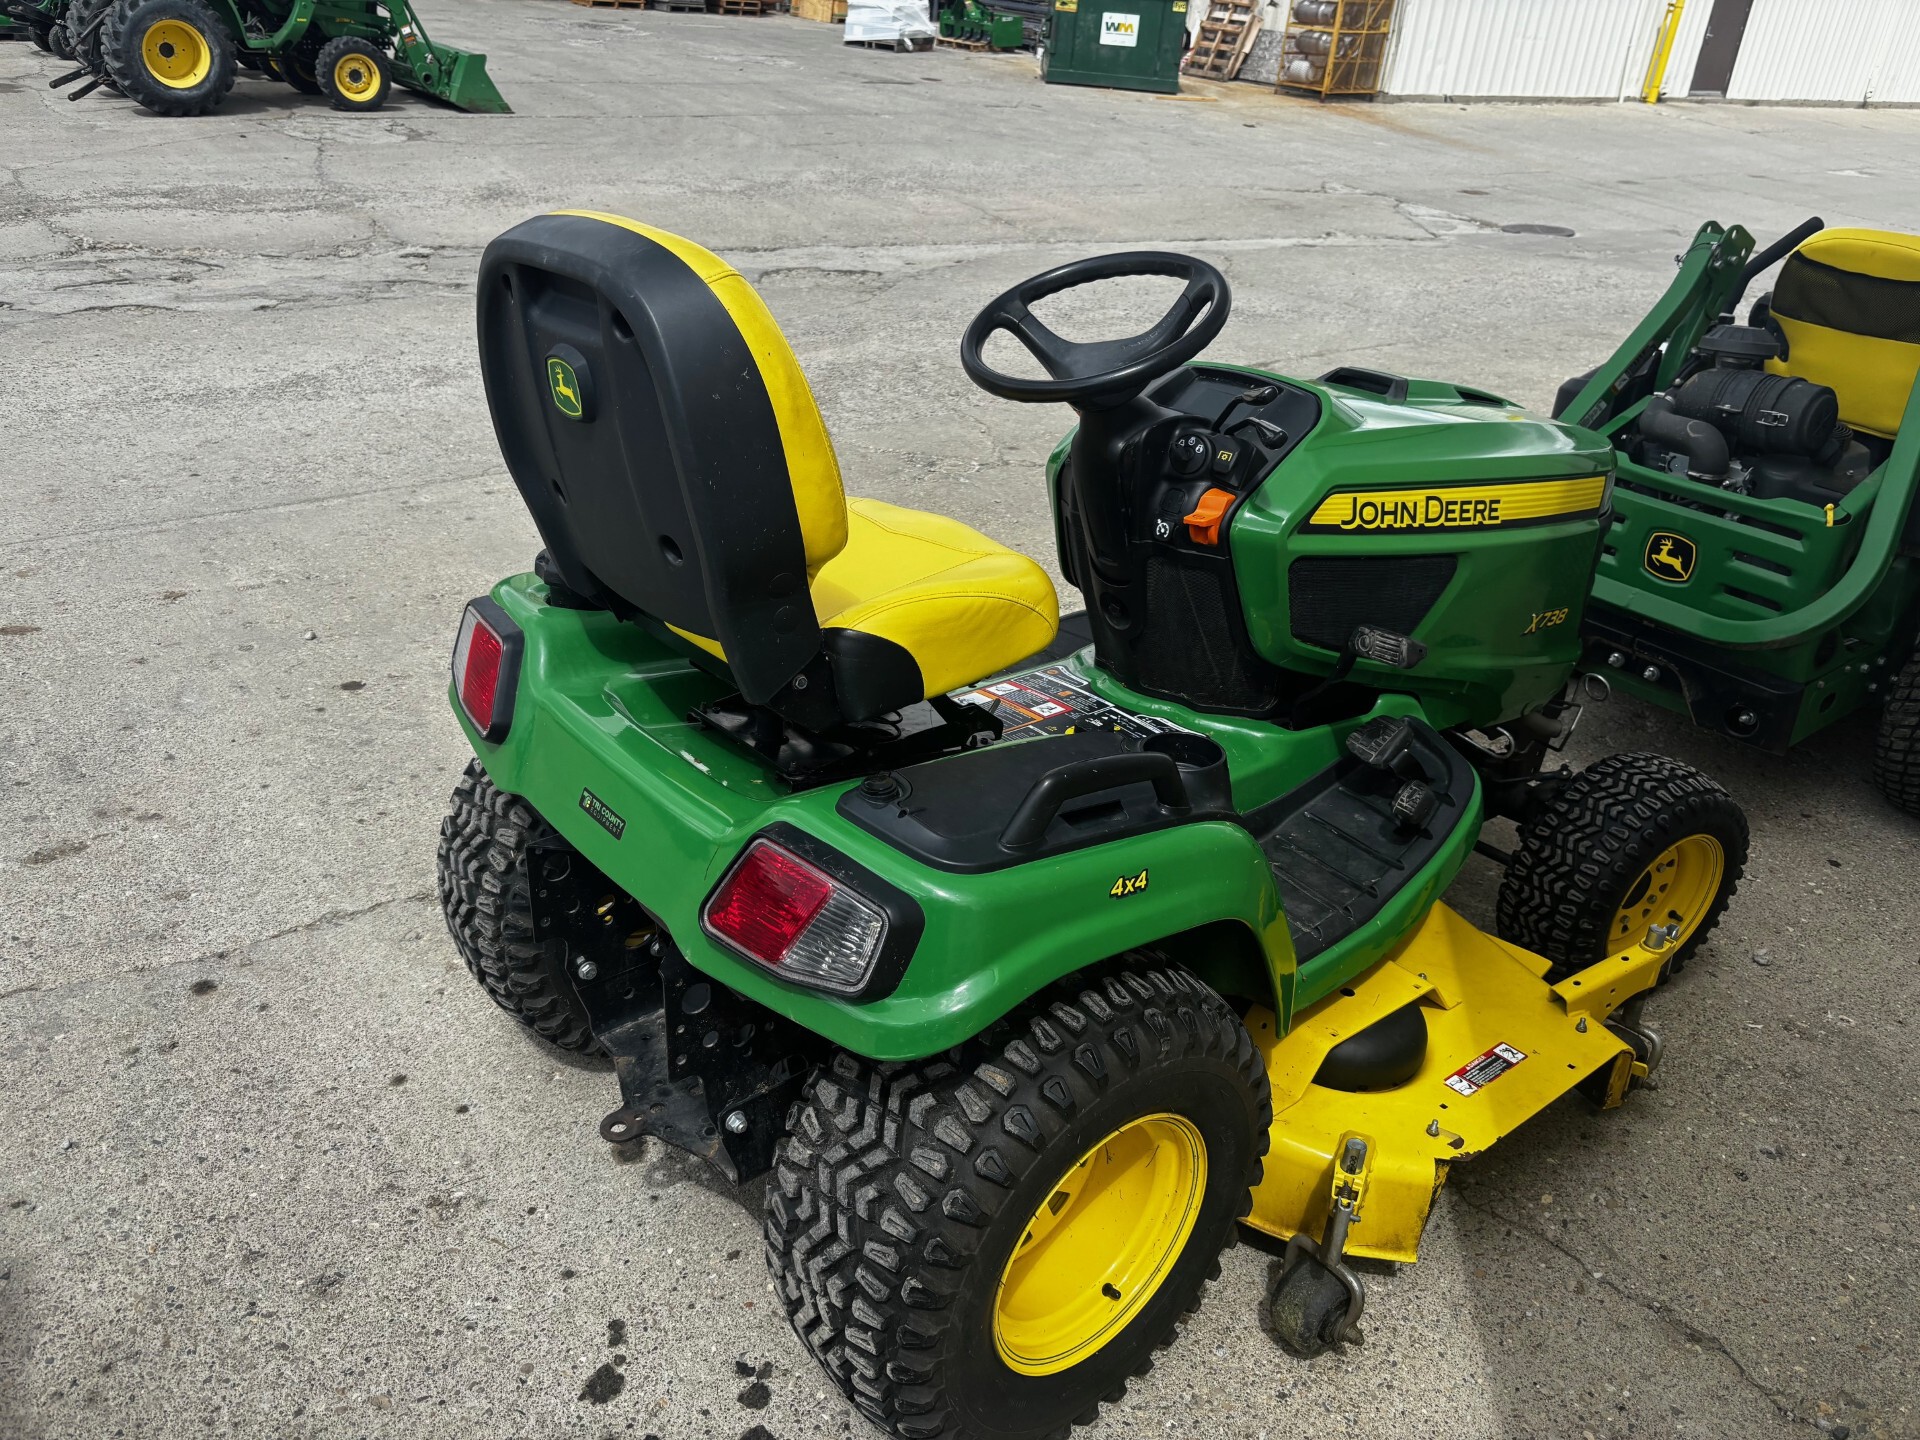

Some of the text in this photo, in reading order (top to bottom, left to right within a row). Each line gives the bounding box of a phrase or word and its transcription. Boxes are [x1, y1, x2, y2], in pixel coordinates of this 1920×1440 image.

[1105, 21, 1134, 33] WM
[1341, 496, 1501, 528] JOHN DEERE
[1522, 607, 1569, 635] X738
[590, 806, 620, 835] EQUIPMENT
[592, 798, 624, 829] TRI COUNTY
[1110, 870, 1147, 896] 4x4
